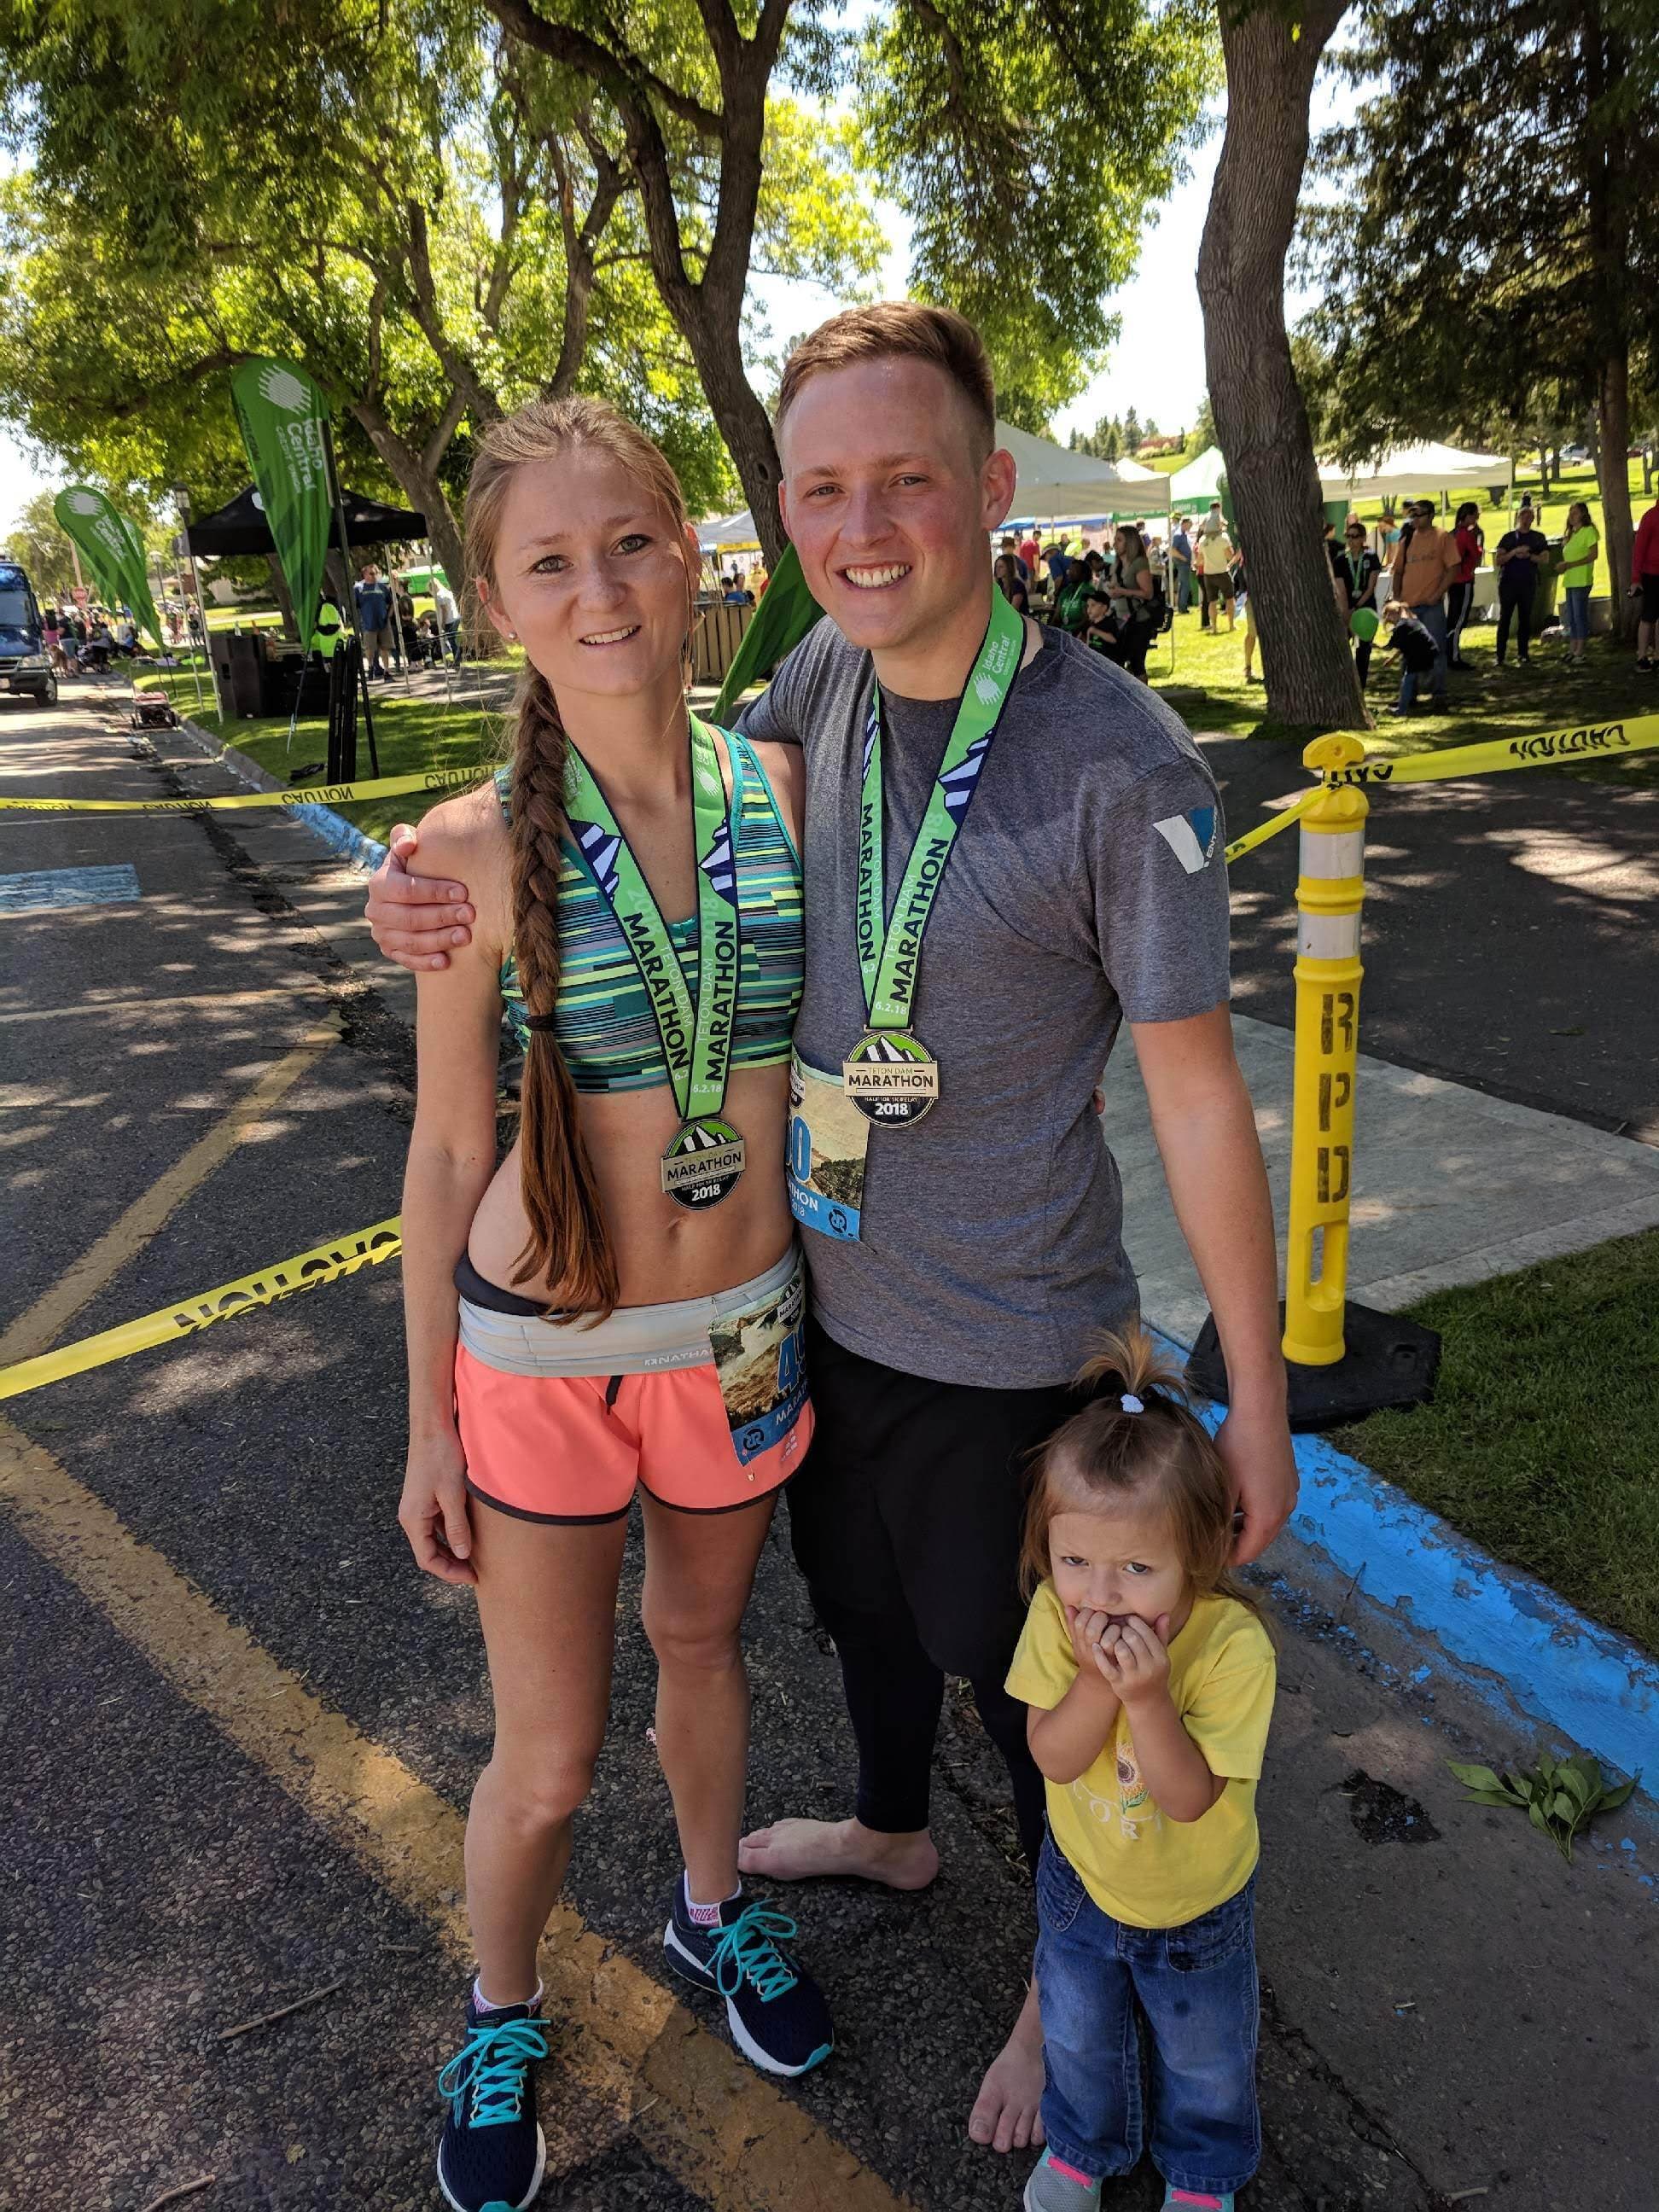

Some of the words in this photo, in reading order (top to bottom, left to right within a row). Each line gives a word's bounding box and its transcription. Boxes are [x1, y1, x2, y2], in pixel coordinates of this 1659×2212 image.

[287, 422, 317, 492] Central
[302, 418, 323, 469] Idaho
[981, 641, 999, 671] Idaho
[992, 635, 1010, 674] Central
[1510, 725, 1631, 760] CAUTION
[859, 802, 876, 962] MARATHON
[872, 885, 884, 919] DAM
[884, 911, 905, 960] TETON
[897, 874, 918, 910] DAM
[890, 838, 949, 1004] MARATHON
[623, 912, 690, 1070] MARATHON
[660, 944, 684, 993] TETON
[677, 994, 693, 1027] DAM
[701, 958, 713, 992] DAM
[697, 996, 711, 1043] TETON
[705, 921, 736, 1081] MARATHON
[875, 1000, 907, 1016] 6.2.18
[692, 1084, 722, 1093] 6.2.18
[848, 1074, 934, 1088] MARATHON
[875, 1103, 909, 1115] 2018
[667, 1151, 742, 1182] MARATHON
[692, 1184, 721, 1202] 2018
